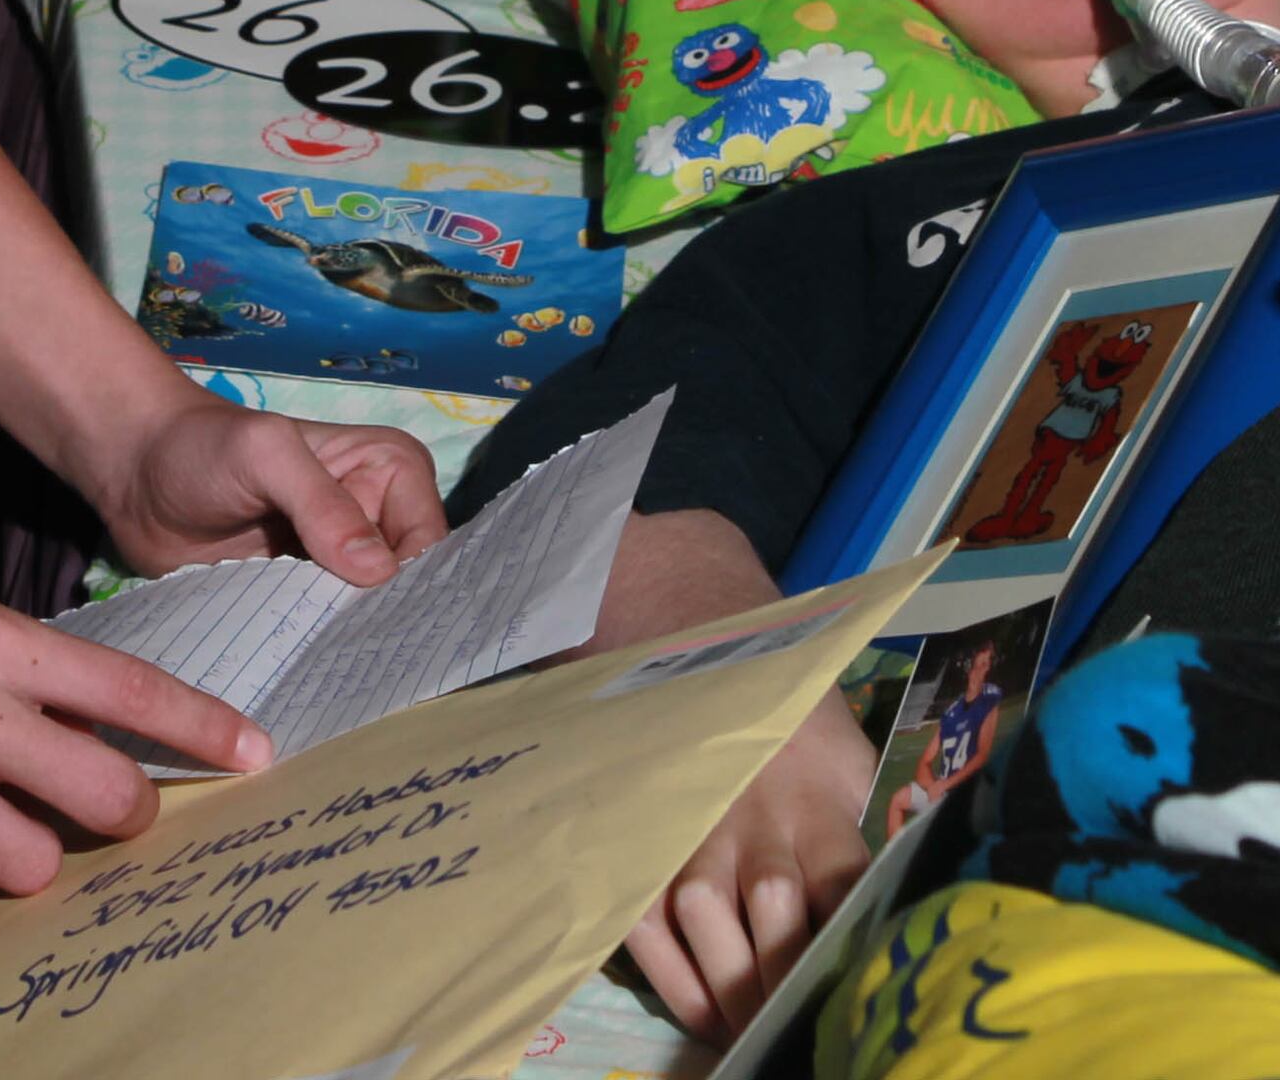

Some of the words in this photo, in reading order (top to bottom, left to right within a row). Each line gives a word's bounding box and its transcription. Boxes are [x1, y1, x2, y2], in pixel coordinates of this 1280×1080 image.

[258, 185, 524, 271] FLORIDA
[151, 809, 306, 875] Lucas
[326, 846, 481, 915] 45502
